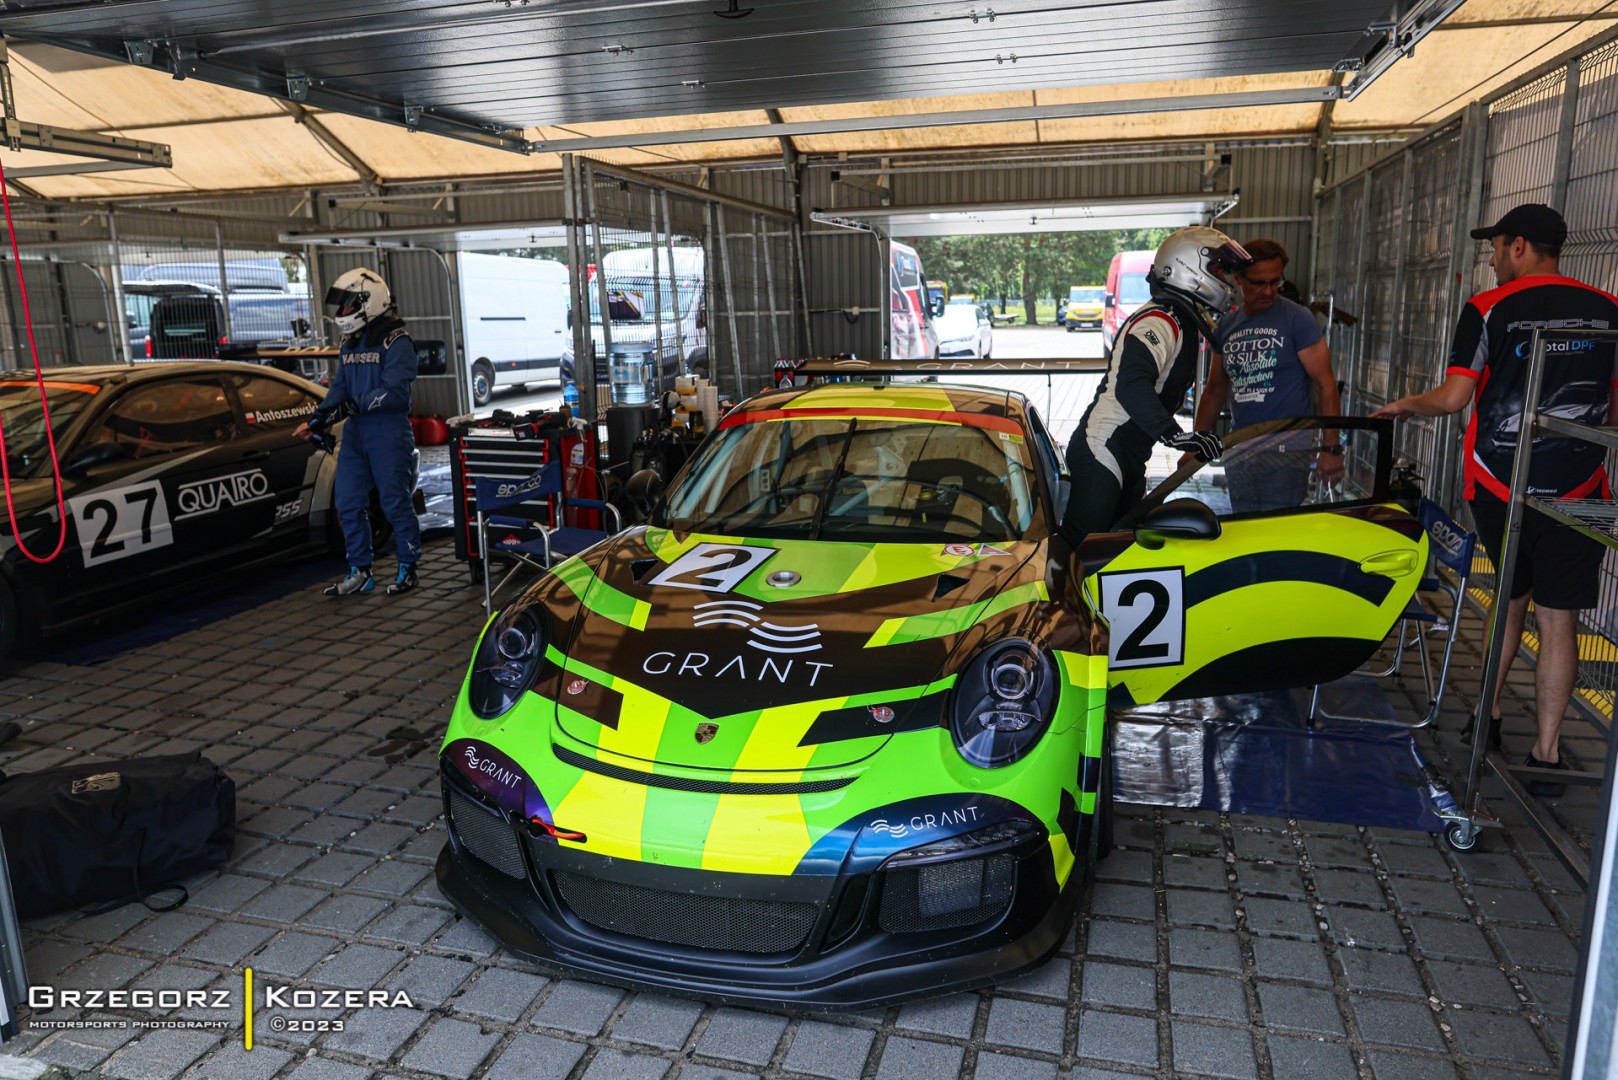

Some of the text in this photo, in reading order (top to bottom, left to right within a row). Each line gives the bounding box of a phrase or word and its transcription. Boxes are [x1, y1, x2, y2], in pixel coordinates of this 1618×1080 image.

[1143, 329, 1161, 347] OMP
[1223, 337, 1284, 353] COTTON
[1229, 328, 1278, 341] QUALITY GOODS
[1571, 340, 1596, 350] DPF
[916, 361, 1081, 370] GRANT
[1226, 350, 1267, 365] & SILK
[1240, 355, 1277, 374] Absolute
[174, 468, 276, 521] QUATRO
[83, 487, 158, 559] 27
[664, 548, 752, 588] 2
[1115, 579, 1170, 661] 2
[642, 651, 834, 687] GRANT
[480, 759, 522, 789] GRANT
[910, 806, 978, 831] GRANT
